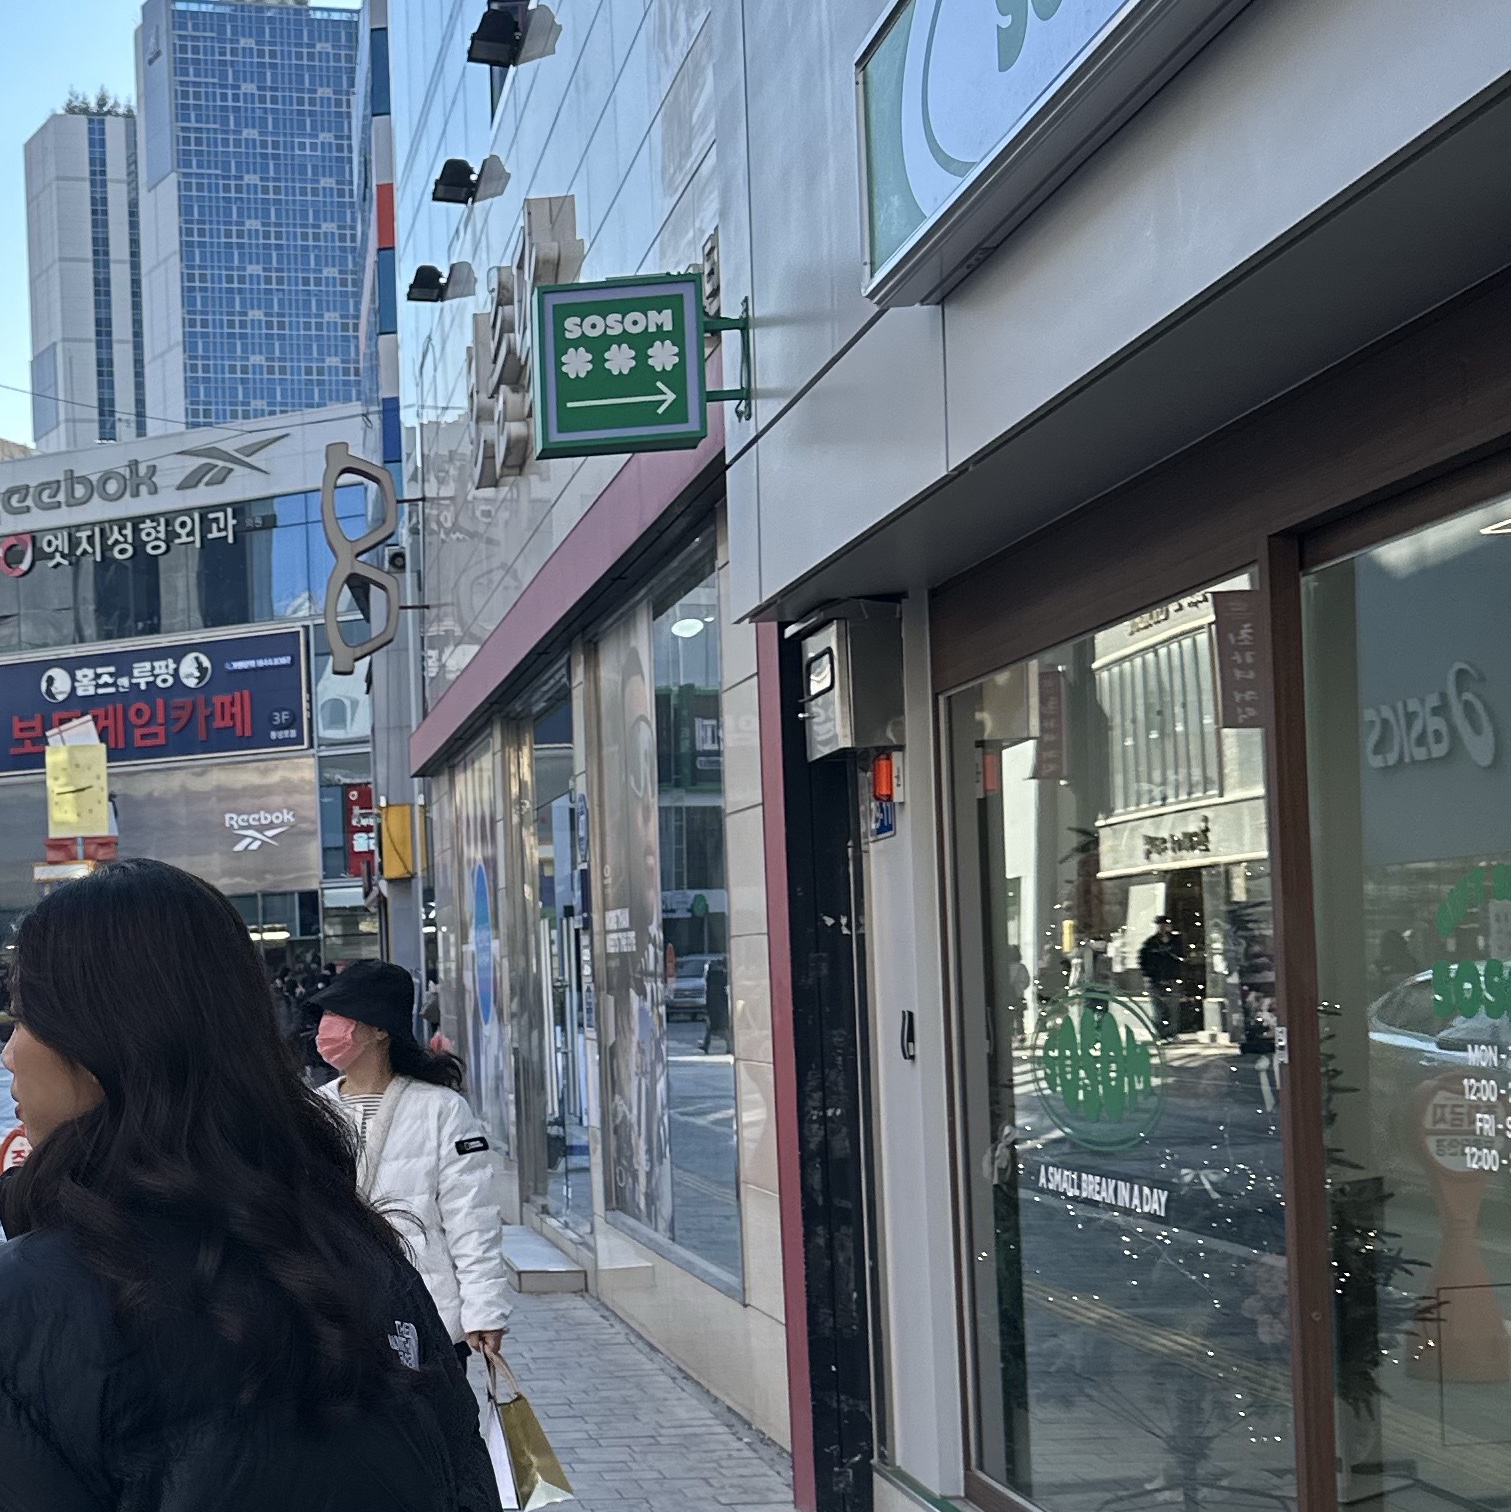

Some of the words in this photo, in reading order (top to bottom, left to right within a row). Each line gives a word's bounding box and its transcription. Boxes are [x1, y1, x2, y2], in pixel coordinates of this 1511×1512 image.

[563, 309, 673, 339] SOSOM
[272, 711, 290, 725] 3F
[224, 808, 296, 829] Reebok
[1467, 1044, 1499, 1068] MON
[1462, 1078, 1498, 1102] 12:00
[1475, 1112, 1496, 1137] FRI
[1464, 1146, 1500, 1172] 12:00
[1038, 1164, 1048, 1189] A
[1047, 1165, 1080, 1197] SMALL
[1080, 1172, 1116, 1205] BREAK
[1116, 1180, 1131, 1209] IN
[1130, 1183, 1142, 1210] A
[1142, 1185, 1169, 1218] DAY
